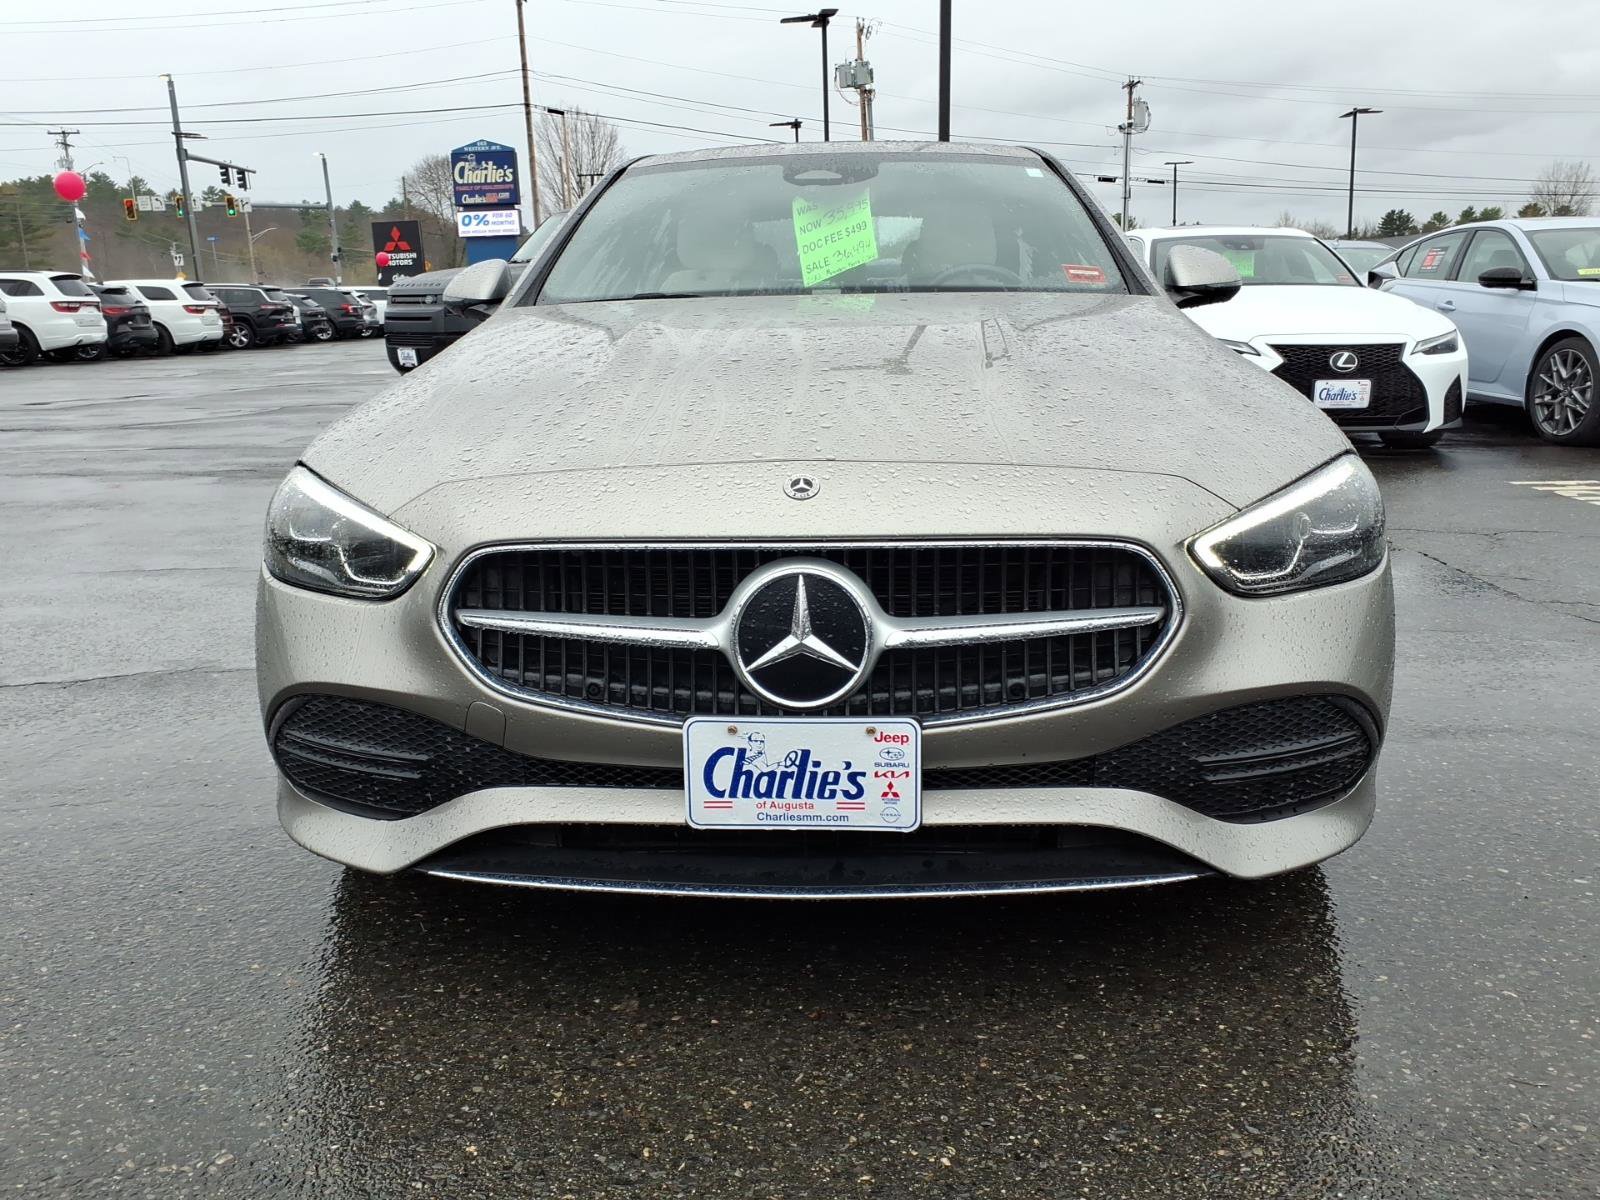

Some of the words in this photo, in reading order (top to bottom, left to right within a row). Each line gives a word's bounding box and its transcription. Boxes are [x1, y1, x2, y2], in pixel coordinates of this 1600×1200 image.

[454, 161, 513, 184] Charlie's
[461, 213, 490, 227] 0%
[799, 219, 822, 235] NOW
[802, 238, 823, 255] DOC
[824, 230, 844, 246] FEE
[805, 256, 831, 274] SALE
[1319, 388, 1358, 401] Charlie's
[874, 731, 909, 745] Jeep
[703, 746, 867, 800] Charlie's
[874, 770, 910, 778] KIA
[756, 801, 767, 809] of
[769, 801, 814, 811] Augusta
[756, 812, 849, 822] Charliesmm.com
